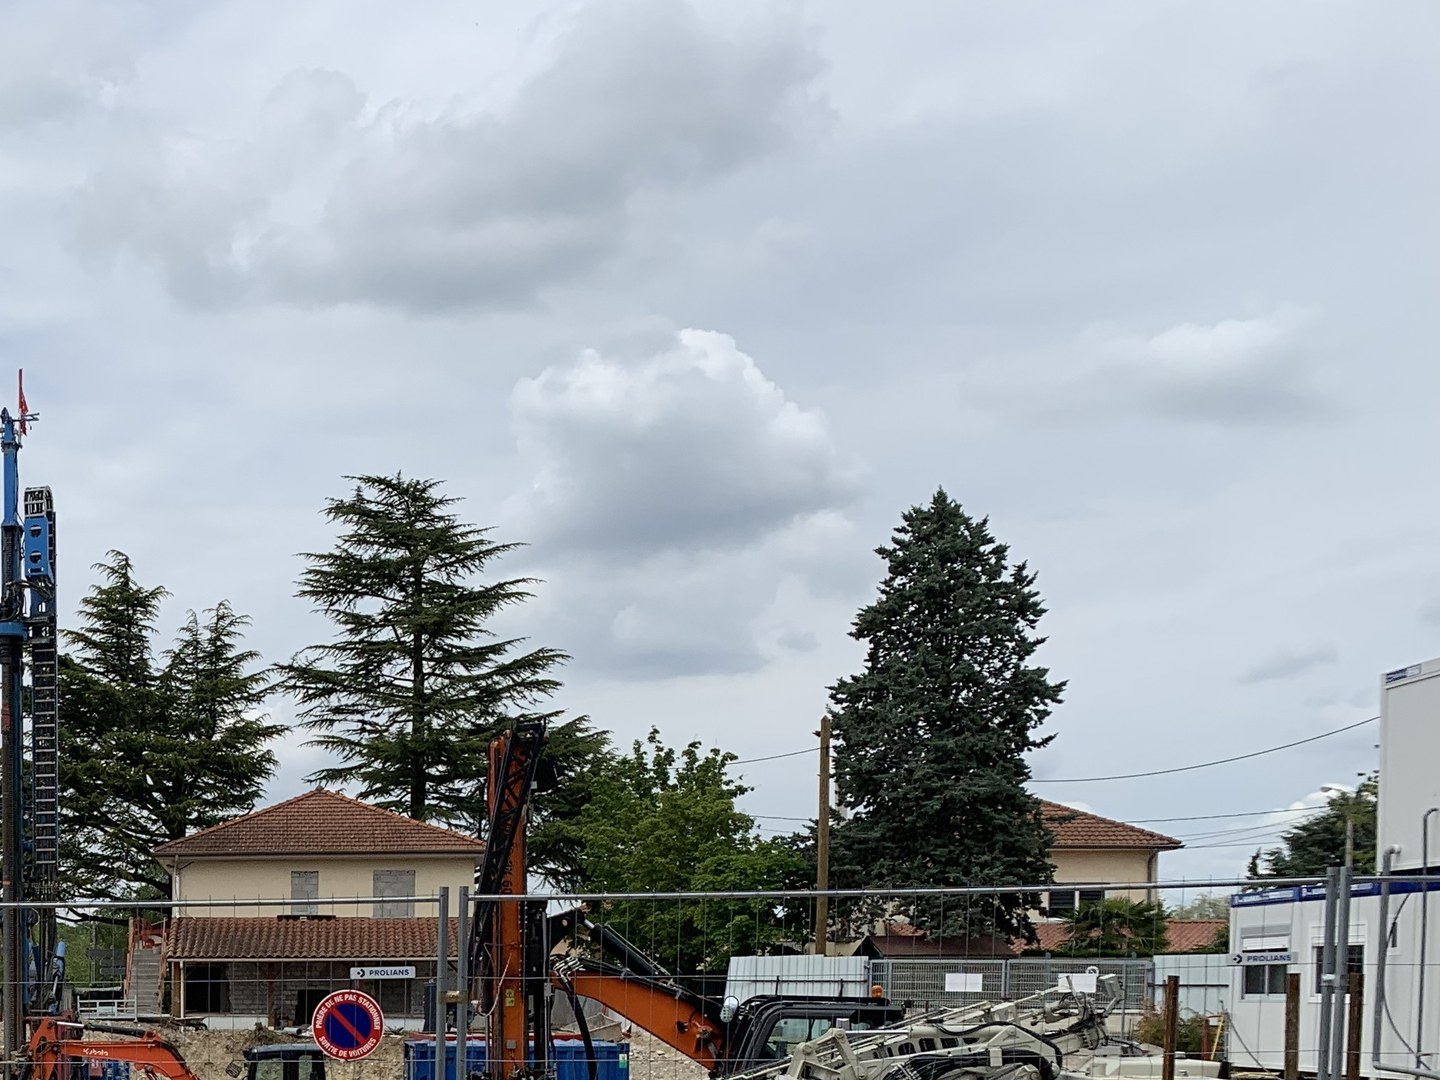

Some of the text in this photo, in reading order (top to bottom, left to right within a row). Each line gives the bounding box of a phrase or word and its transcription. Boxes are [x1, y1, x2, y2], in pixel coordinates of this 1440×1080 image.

[1246, 954, 1292, 962] PROLIANS
[369, 968, 410, 976] PROLIANS
[325, 998, 335, 1009] DE
[334, 994, 344, 1004] NE
[344, 993, 357, 1002] PAS
[318, 1036, 377, 1058] SORTIE DE VOITURES
